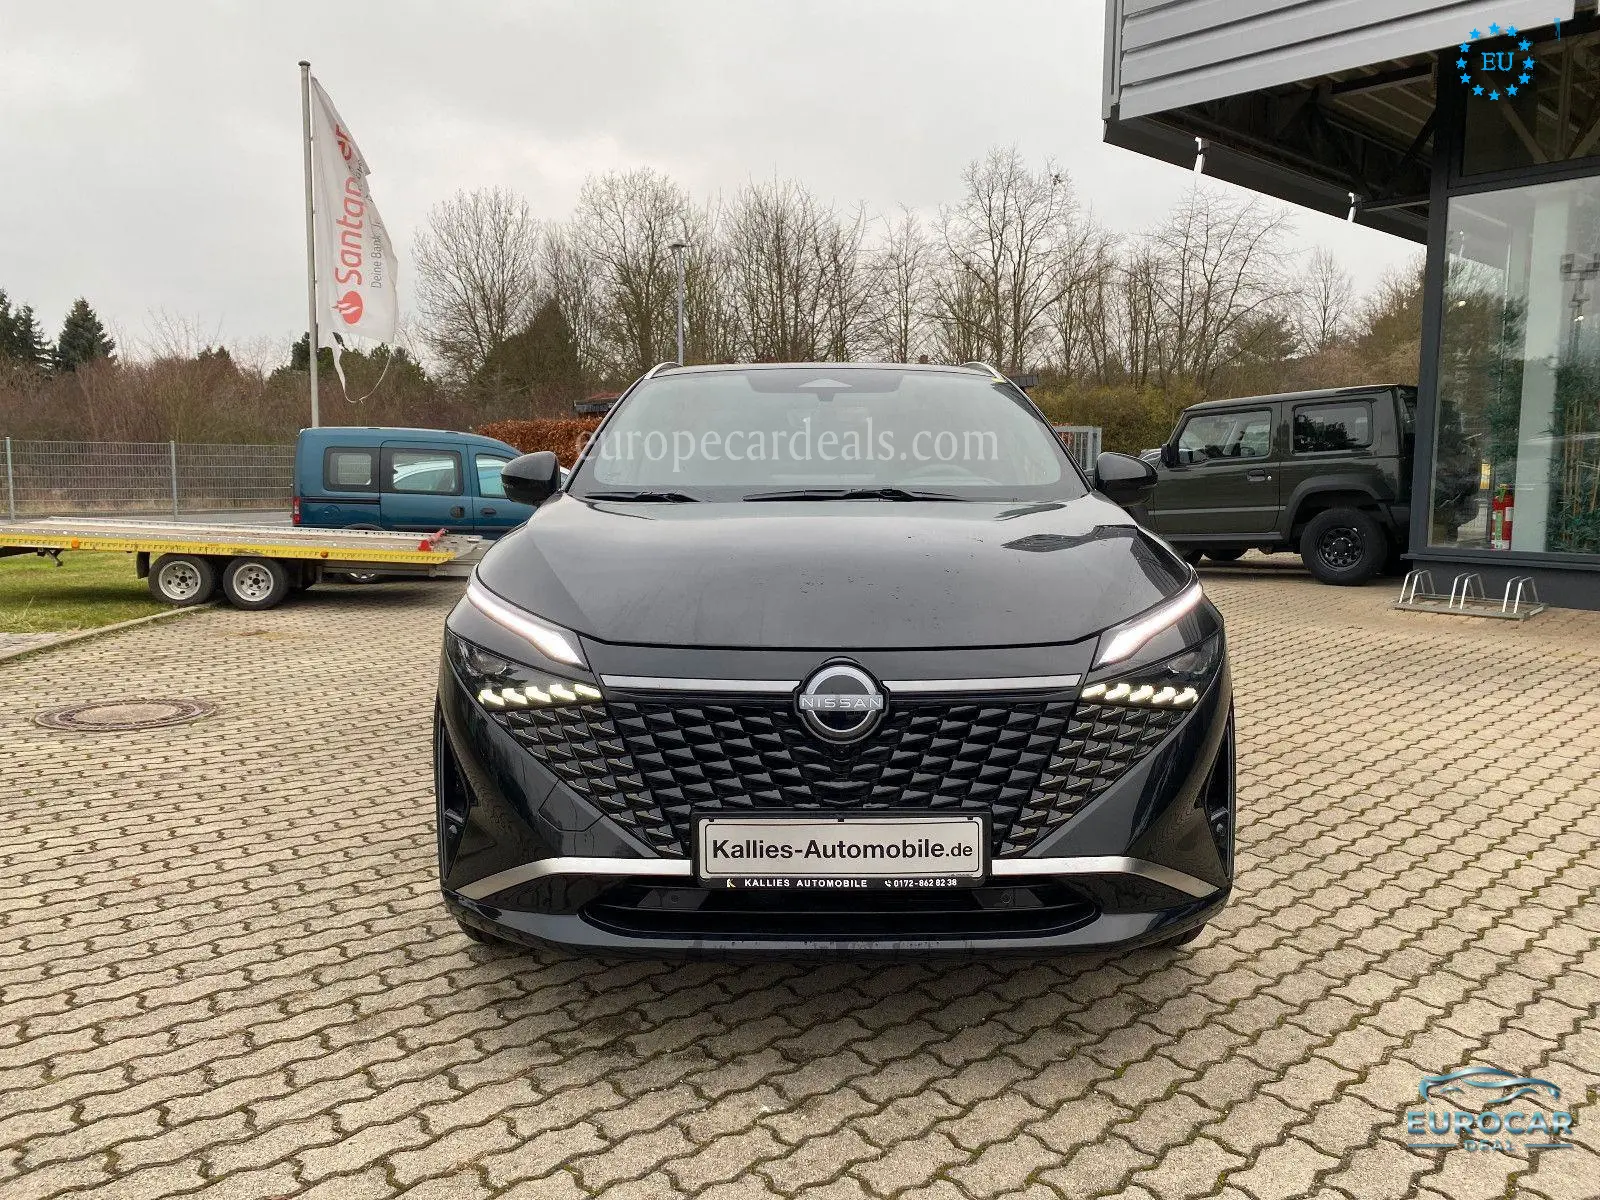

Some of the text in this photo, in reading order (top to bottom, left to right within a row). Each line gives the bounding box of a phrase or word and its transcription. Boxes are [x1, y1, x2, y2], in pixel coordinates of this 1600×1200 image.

[334, 124, 366, 285] Santaner
[370, 260, 382, 288] Deine
[801, 697, 881, 708] NISSAN
[711, 838, 973, 859] Kallies-Automobile.de
[744, 878, 868, 887] KALLIES AUTOMOBILE
